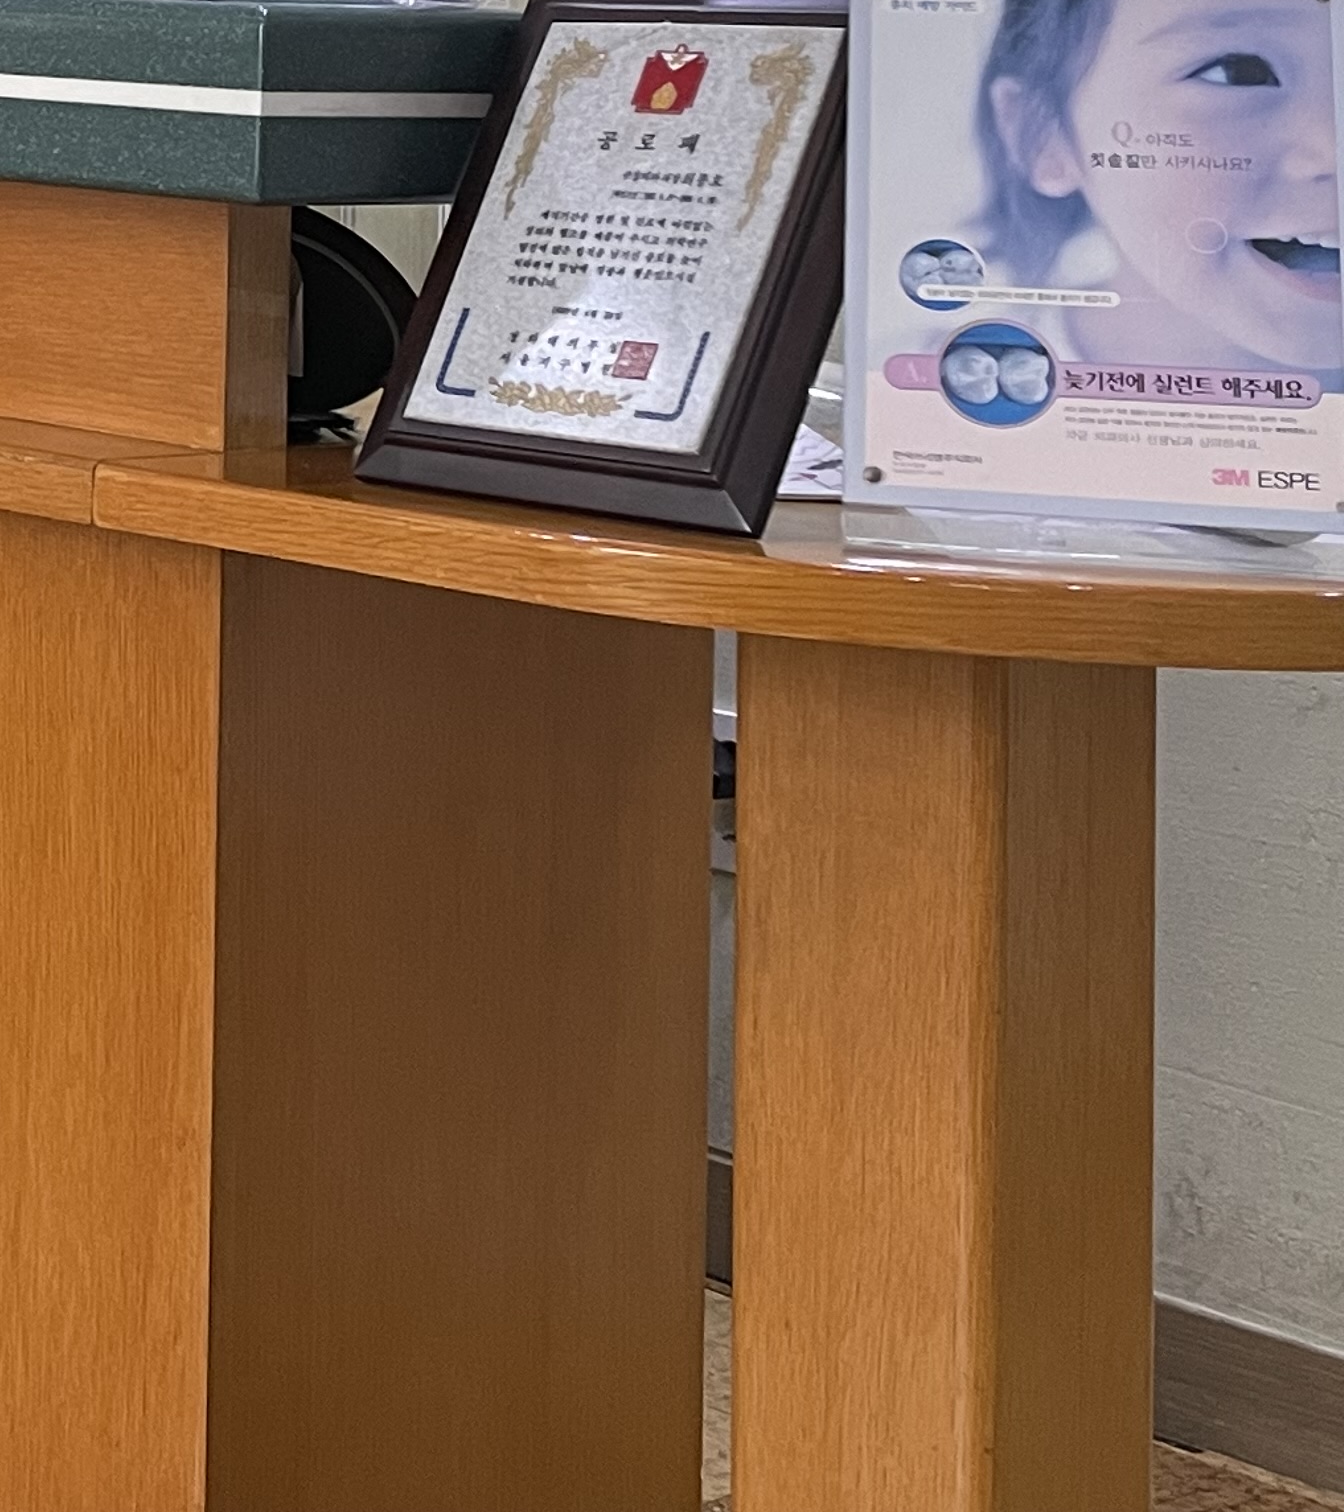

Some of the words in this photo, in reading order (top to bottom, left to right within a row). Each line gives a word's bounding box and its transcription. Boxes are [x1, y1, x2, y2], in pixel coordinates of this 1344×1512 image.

[1145, 132, 1194, 148] 아직도
[1090, 152, 1158, 171] 칫솔질만
[1165, 155, 1252, 174] 시키시나요?
[1063, 369, 1146, 395] 늦기전에
[1151, 375, 1217, 396] 실런트
[1221, 378, 1313, 402] 해주세요.
[1212, 469, 1250, 487] 3M
[1258, 471, 1322, 491] ESPE
